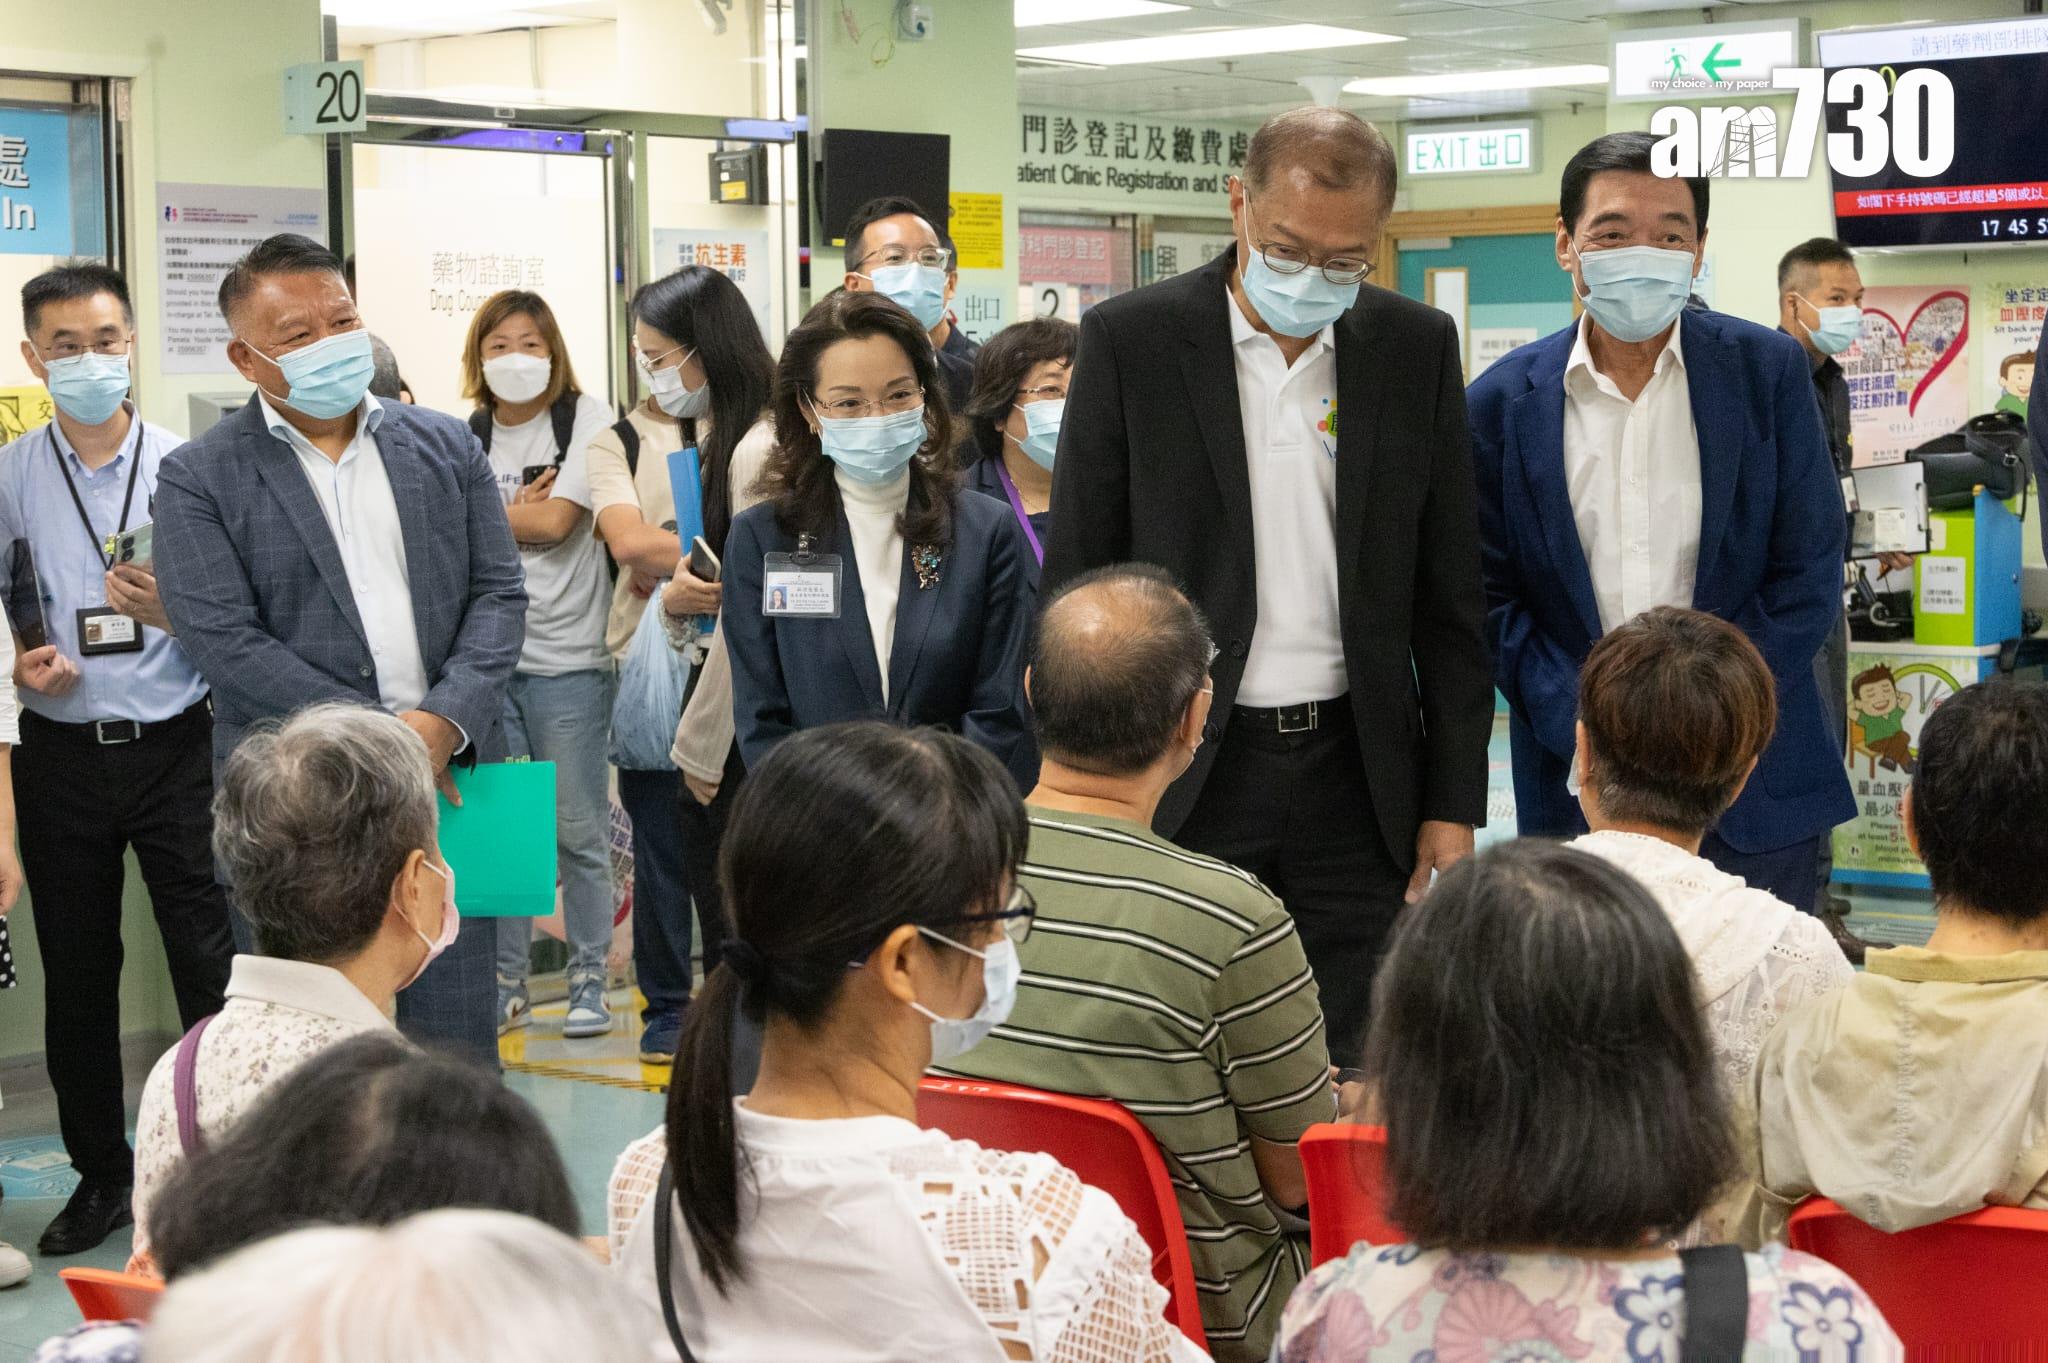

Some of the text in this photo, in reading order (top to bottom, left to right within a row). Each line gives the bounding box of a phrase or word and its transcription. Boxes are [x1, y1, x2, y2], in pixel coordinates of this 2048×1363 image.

[316, 69, 361, 124] 20
[1415, 132, 1523, 170] EXIT 出口
[1061, 163, 1102, 187] Clinic
[1106, 166, 1188, 193] Registration
[1192, 174, 1218, 193] and
[2, 196, 36, 230] In
[1981, 220, 2000, 237] 17
[2008, 218, 2029, 235] 45
[695, 243, 747, 267] 抗生素
[430, 287, 454, 318] Drug
[965, 295, 1000, 322] 出口
[1856, 780, 1902, 798] 量血壓
